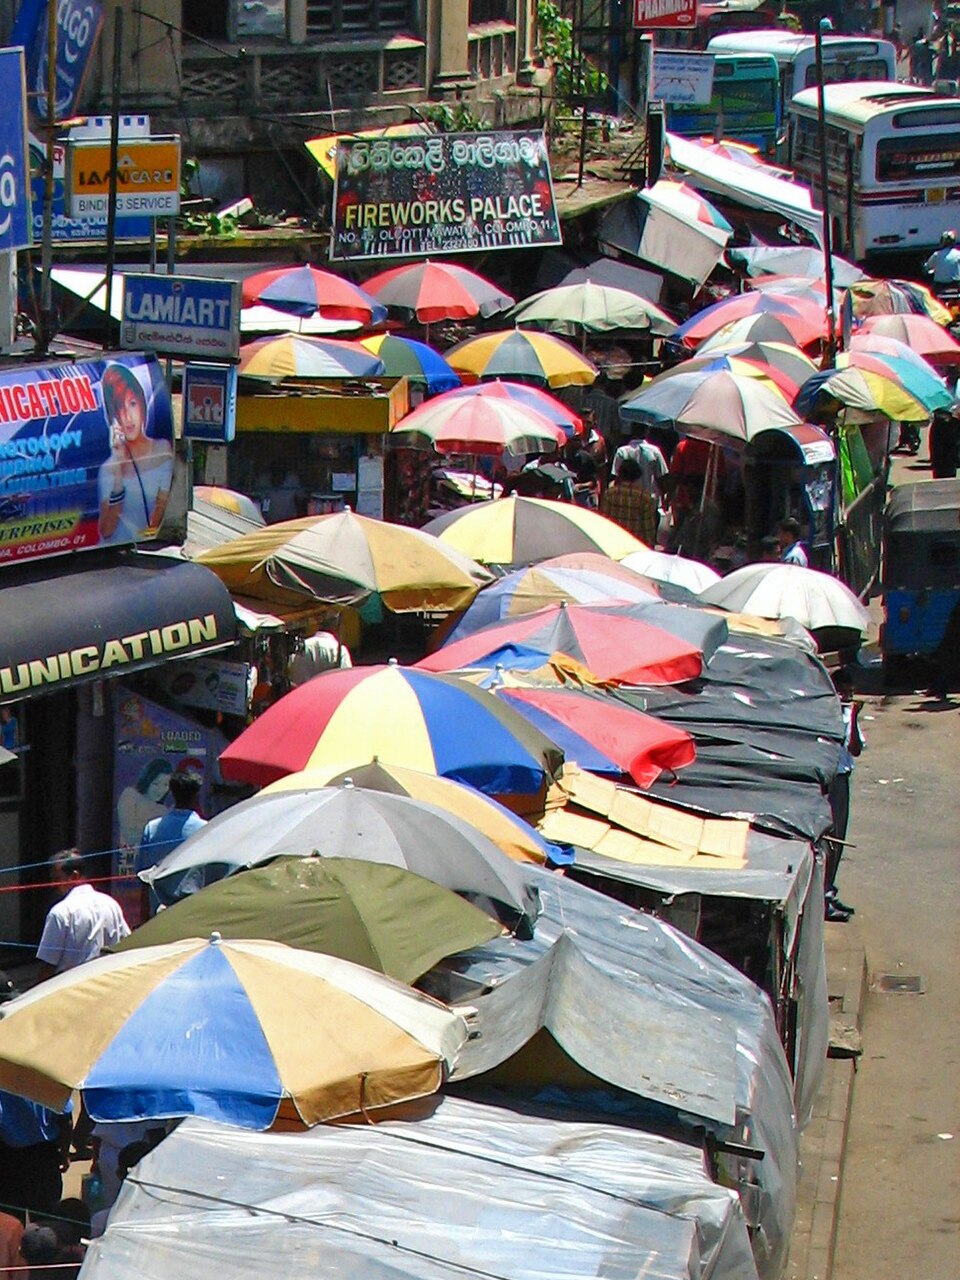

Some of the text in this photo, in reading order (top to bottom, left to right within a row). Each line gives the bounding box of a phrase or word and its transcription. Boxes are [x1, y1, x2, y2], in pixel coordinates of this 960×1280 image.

[78, 196, 172, 212] BINDIG SERVICE
[345, 194, 544, 229] FIREWORKS PALACE
[380, 227, 424, 241] OLCOTT
[484, 220, 538, 234] COLOMBO
[126, 292, 230, 328] LAMIART
[190, 397, 223, 422] kit
